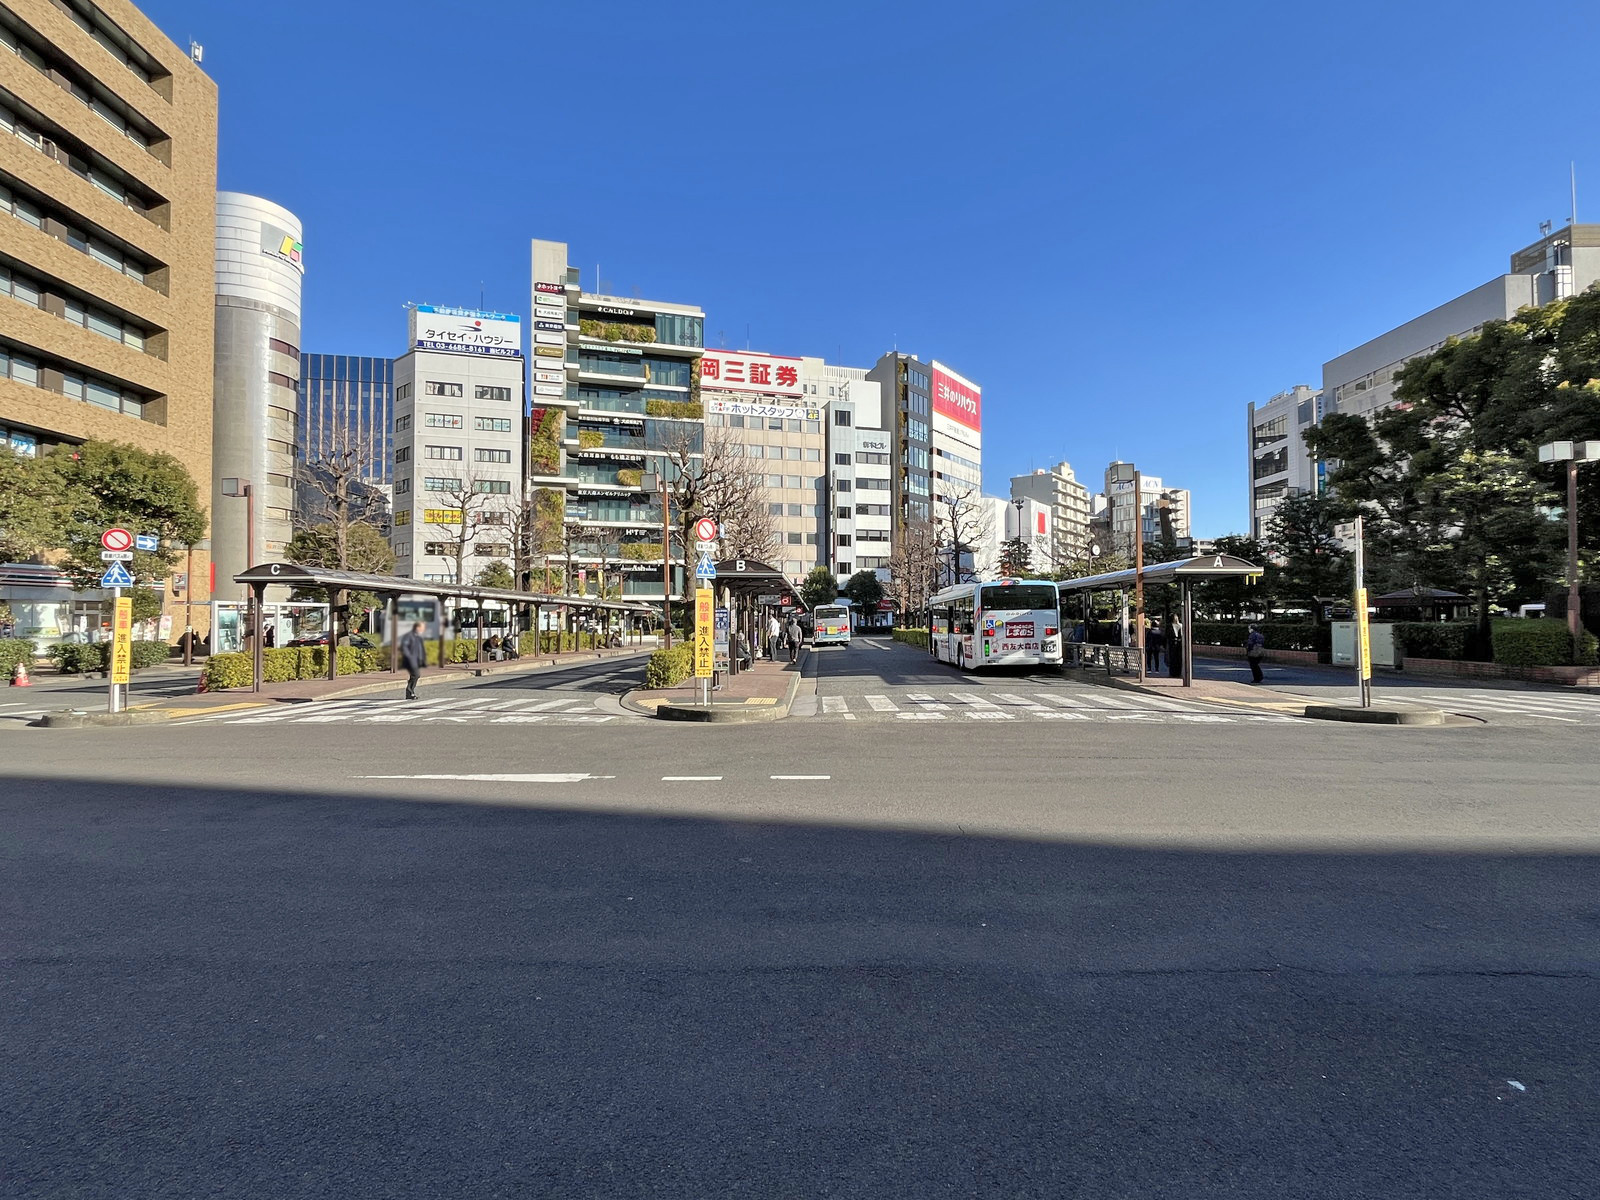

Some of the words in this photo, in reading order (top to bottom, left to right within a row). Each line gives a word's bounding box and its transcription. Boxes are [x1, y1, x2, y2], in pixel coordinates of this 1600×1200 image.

[425, 329, 513, 345] タイセイ・ハウジー
[701, 358, 798, 387] 岡三証券
[938, 382, 977, 415] 三井のリハウス
[731, 404, 794, 417] ホットスタッフ
[271, 564, 280, 575] C
[736, 560, 746, 572] B
[1213, 556, 1223, 567] A
[699, 594, 710, 622] 一般車
[115, 633, 127, 675] 進入禁止
[699, 626, 710, 668] 進入禁止
